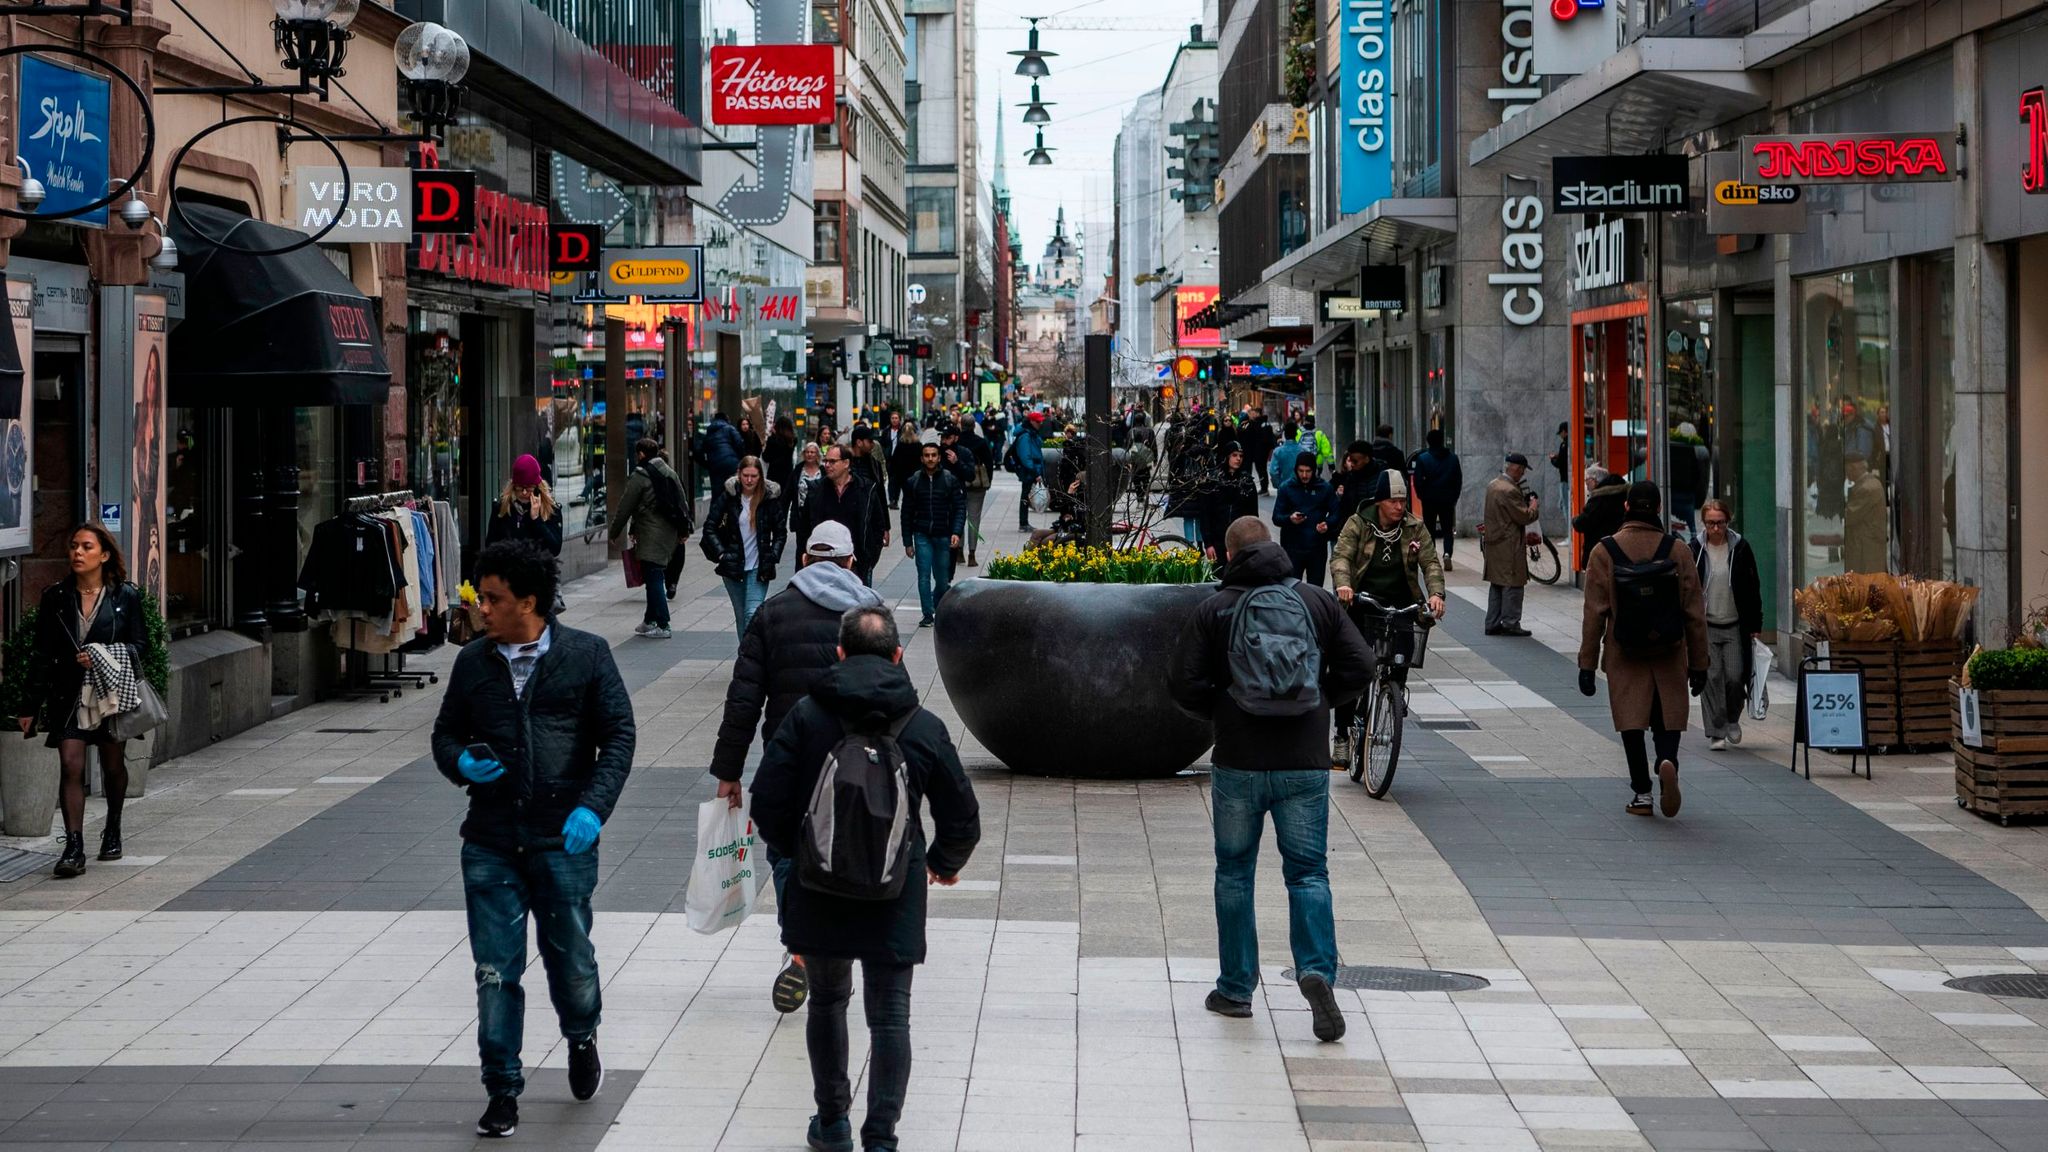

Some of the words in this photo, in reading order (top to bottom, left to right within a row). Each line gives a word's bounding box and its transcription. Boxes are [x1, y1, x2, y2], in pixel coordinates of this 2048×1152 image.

[719, 57, 828, 97] Hötorgs
[725, 95, 821, 110] PASSAGEN
[1350, 69, 1384, 152] clas
[309, 181, 398, 203] VERO
[1560, 180, 1683, 206] stadium
[302, 207, 404, 228] MODA
[1489, 197, 1544, 325] clas
[1575, 213, 1624, 291] stadium
[616, 264, 684, 278] GULDFYND
[71, 287, 89, 306] RADO
[759, 295, 798, 321] H&M
[1365, 300, 1402, 309] BROTHERS
[329, 304, 357, 339] STEP
[1812, 693, 1855, 710] 25%
